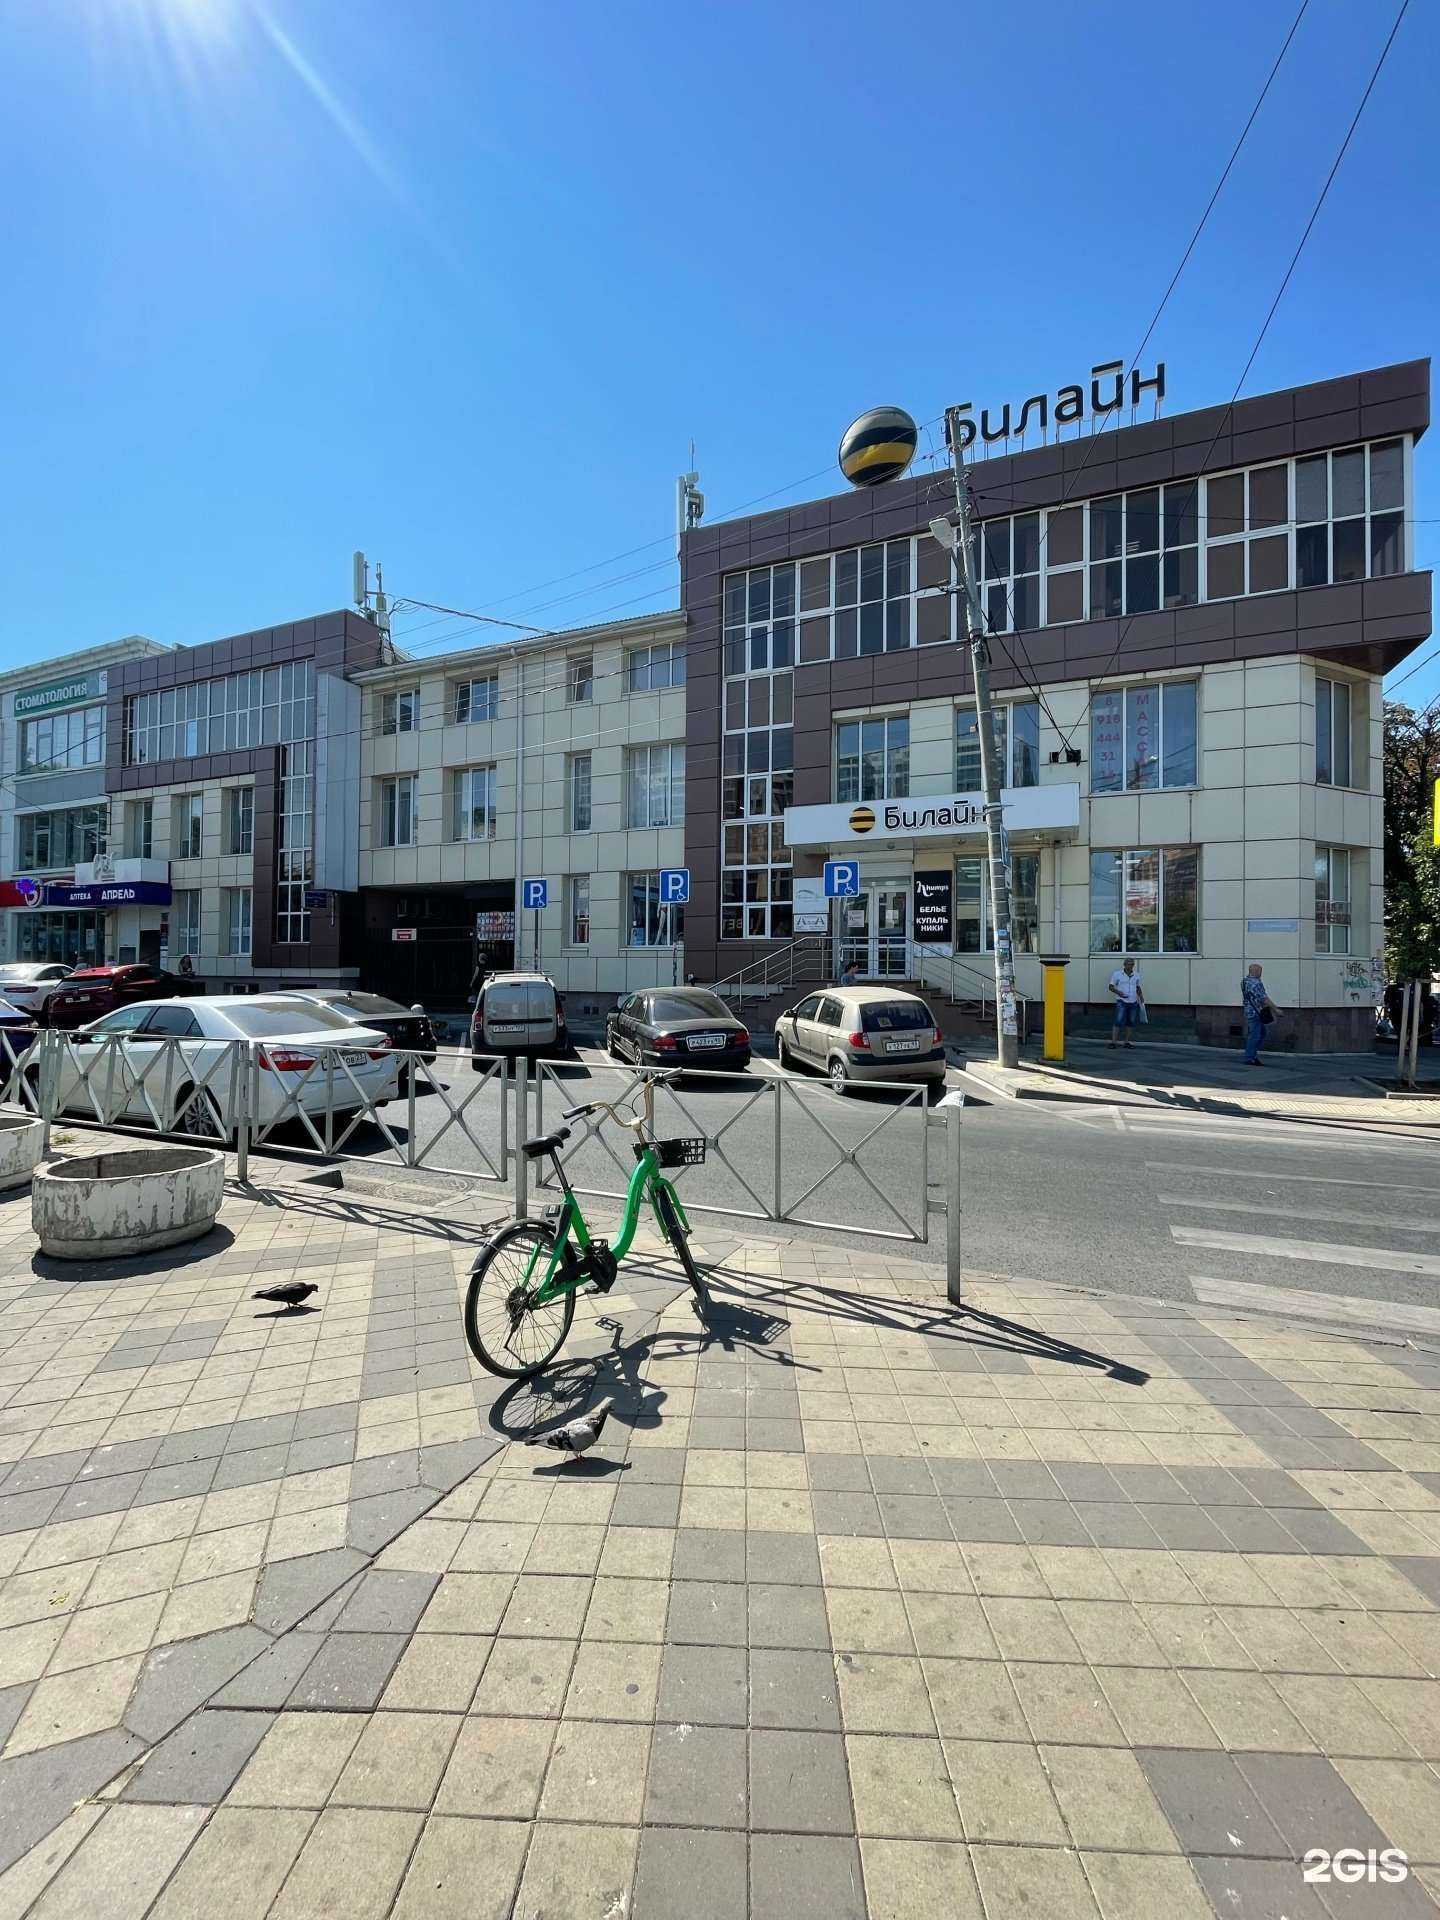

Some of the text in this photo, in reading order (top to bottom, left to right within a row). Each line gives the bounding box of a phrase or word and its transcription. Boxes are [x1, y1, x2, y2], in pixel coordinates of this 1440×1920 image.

[944, 360, 1166, 450] Билайн
[14, 682, 88, 710] СТОМАТОЛОГИЯ
[885, 800, 987, 830] Билайн
[101, 888, 135, 900] АПРЕЛЬ
